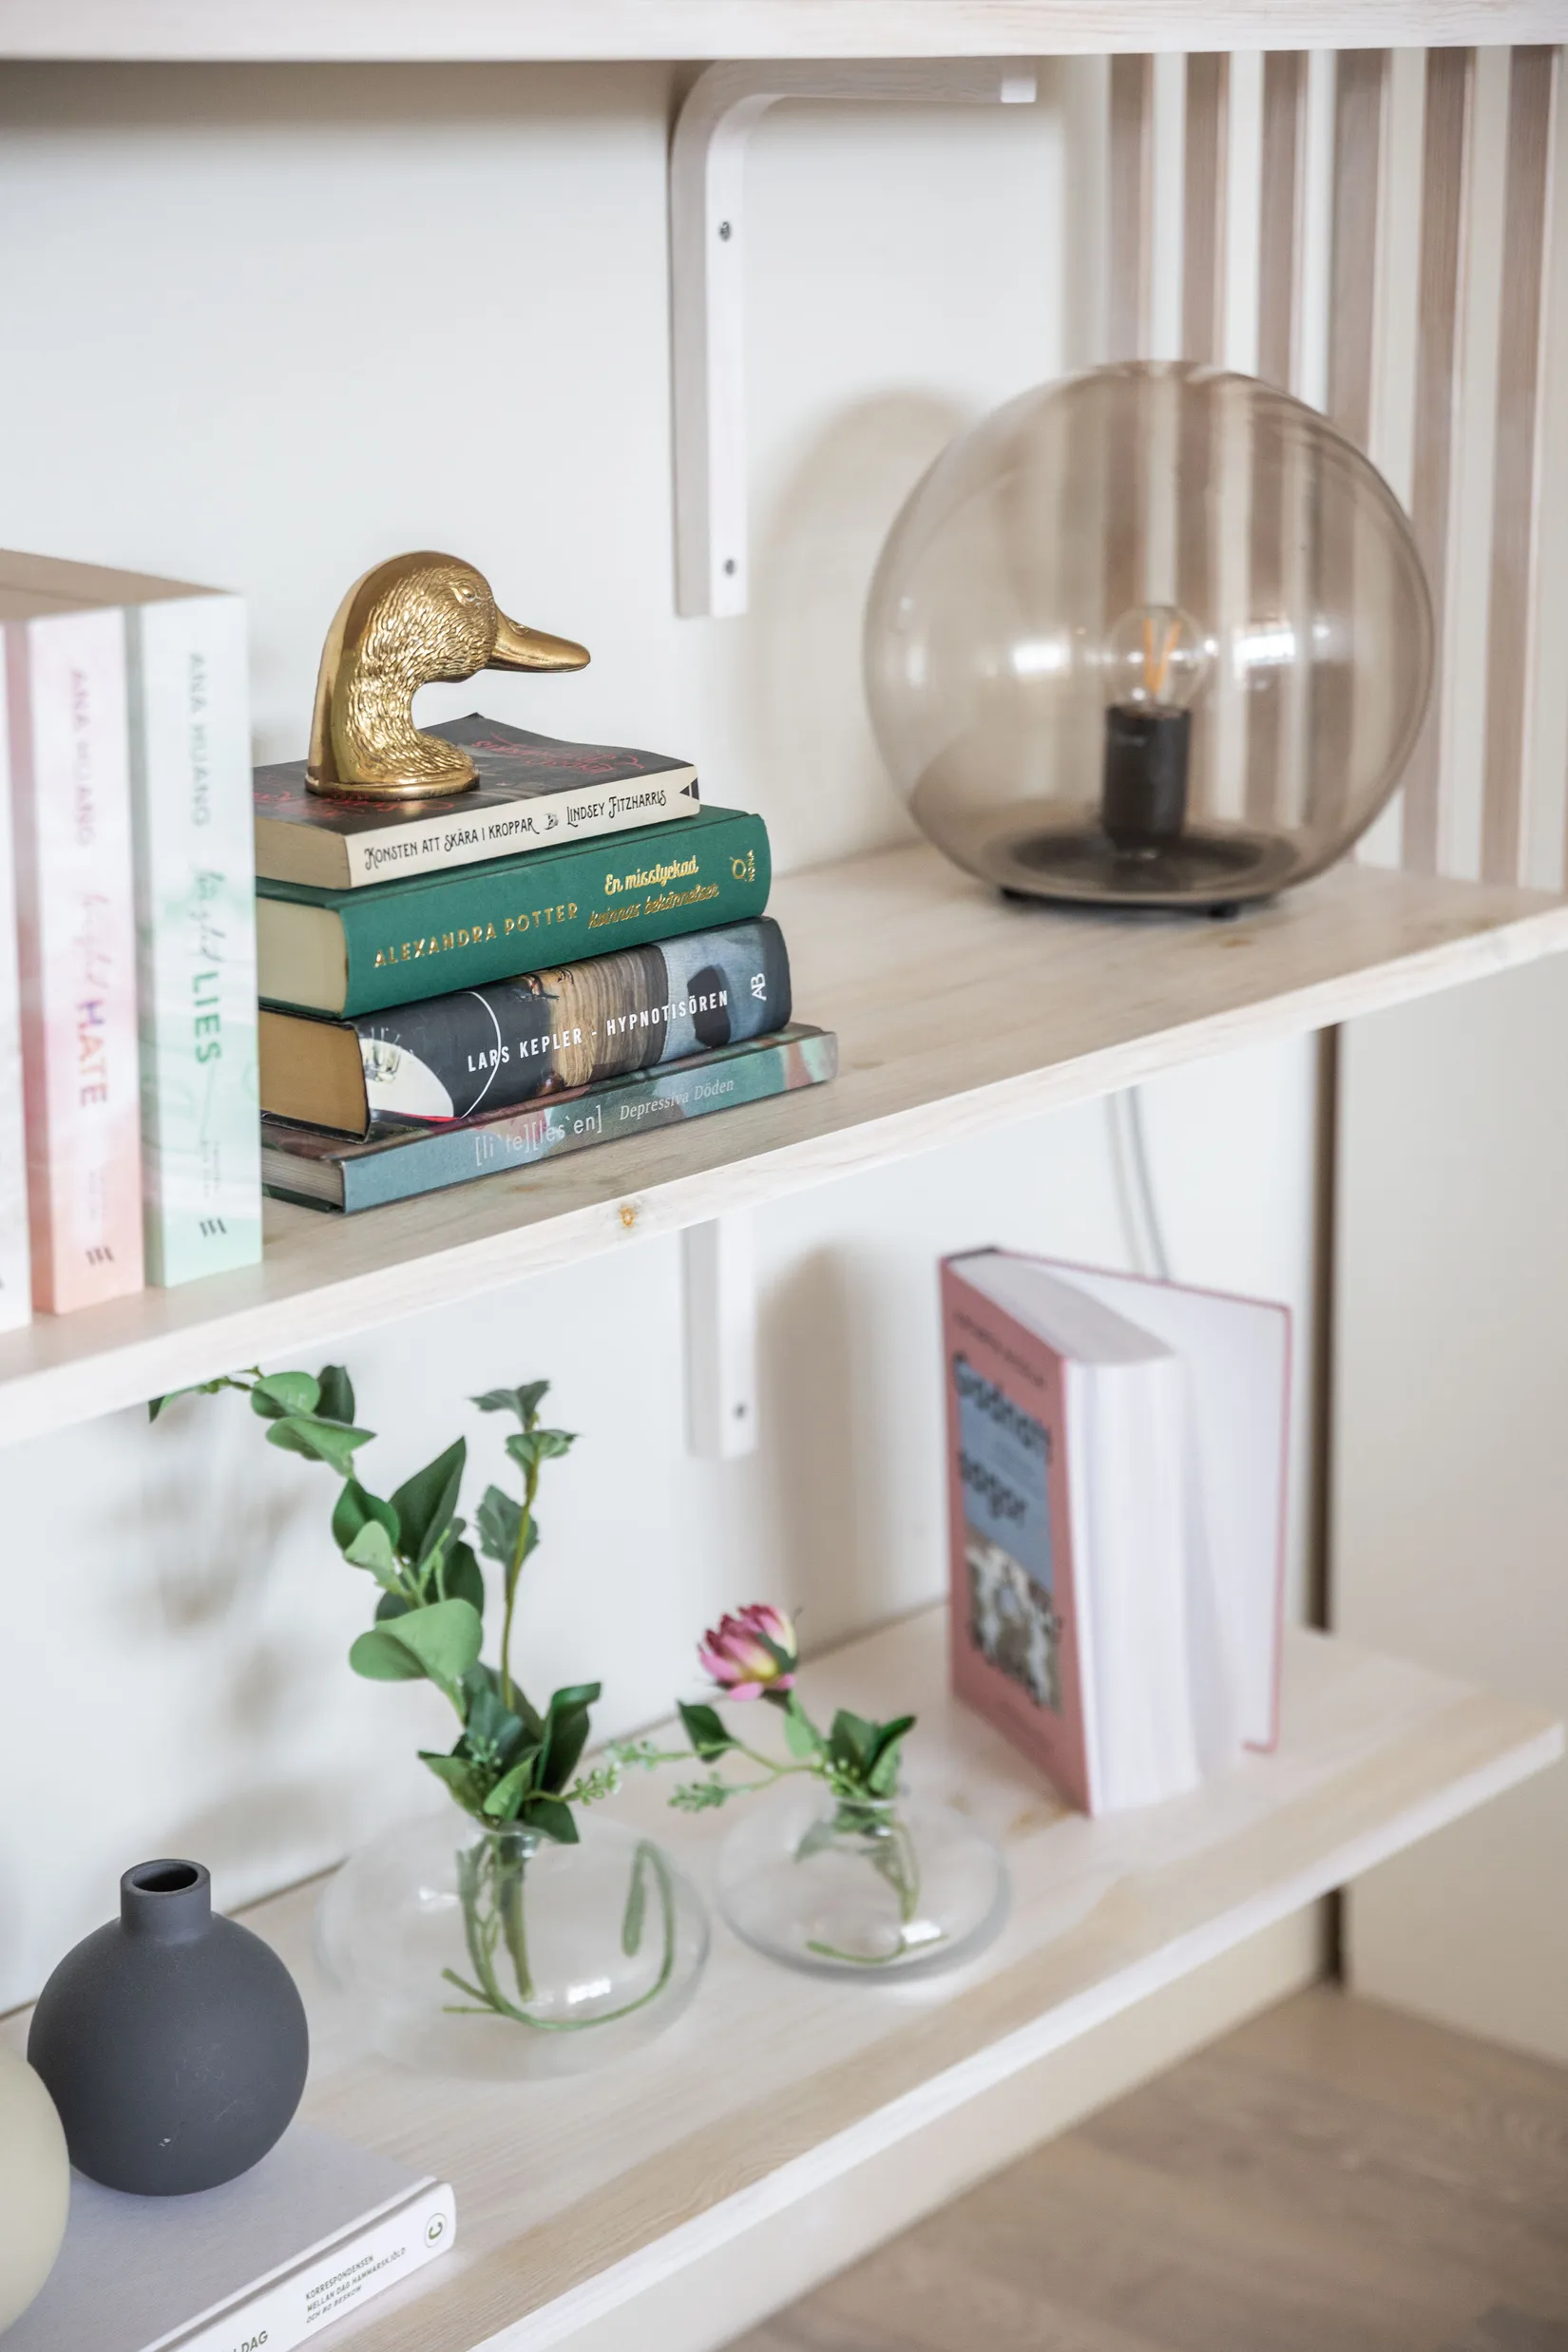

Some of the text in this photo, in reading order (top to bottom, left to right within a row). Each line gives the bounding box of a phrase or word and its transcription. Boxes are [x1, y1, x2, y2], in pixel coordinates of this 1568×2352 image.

[364, 790, 667, 871] KONSTEN ATT SKÄRA I KROPPAR LINDSEY FITZHARRIS
[603, 854, 700, 896] En misslyckad
[746, 849, 756, 883] NONA
[587, 883, 721, 930] kvinnas bekännelser
[373, 902, 579, 969] ALEXANDRA POTTER
[750, 972, 768, 1003] AB
[192, 970, 223, 1064] LIES
[467, 1045, 511, 1073] LARS
[519, 1029, 583, 1060] KEPLER
[605, 989, 729, 1038] HYPNOTISÖREN
[77, 998, 108, 1109] HATE
[619, 1092, 690, 1122] Depressiva
[694, 1078, 735, 1102] Döden
[305, 2254, 374, 2301] KORRESPONDENSEN
[335, 2280, 351, 2296] DAG
[240, 2329, 269, 2352] DAG
